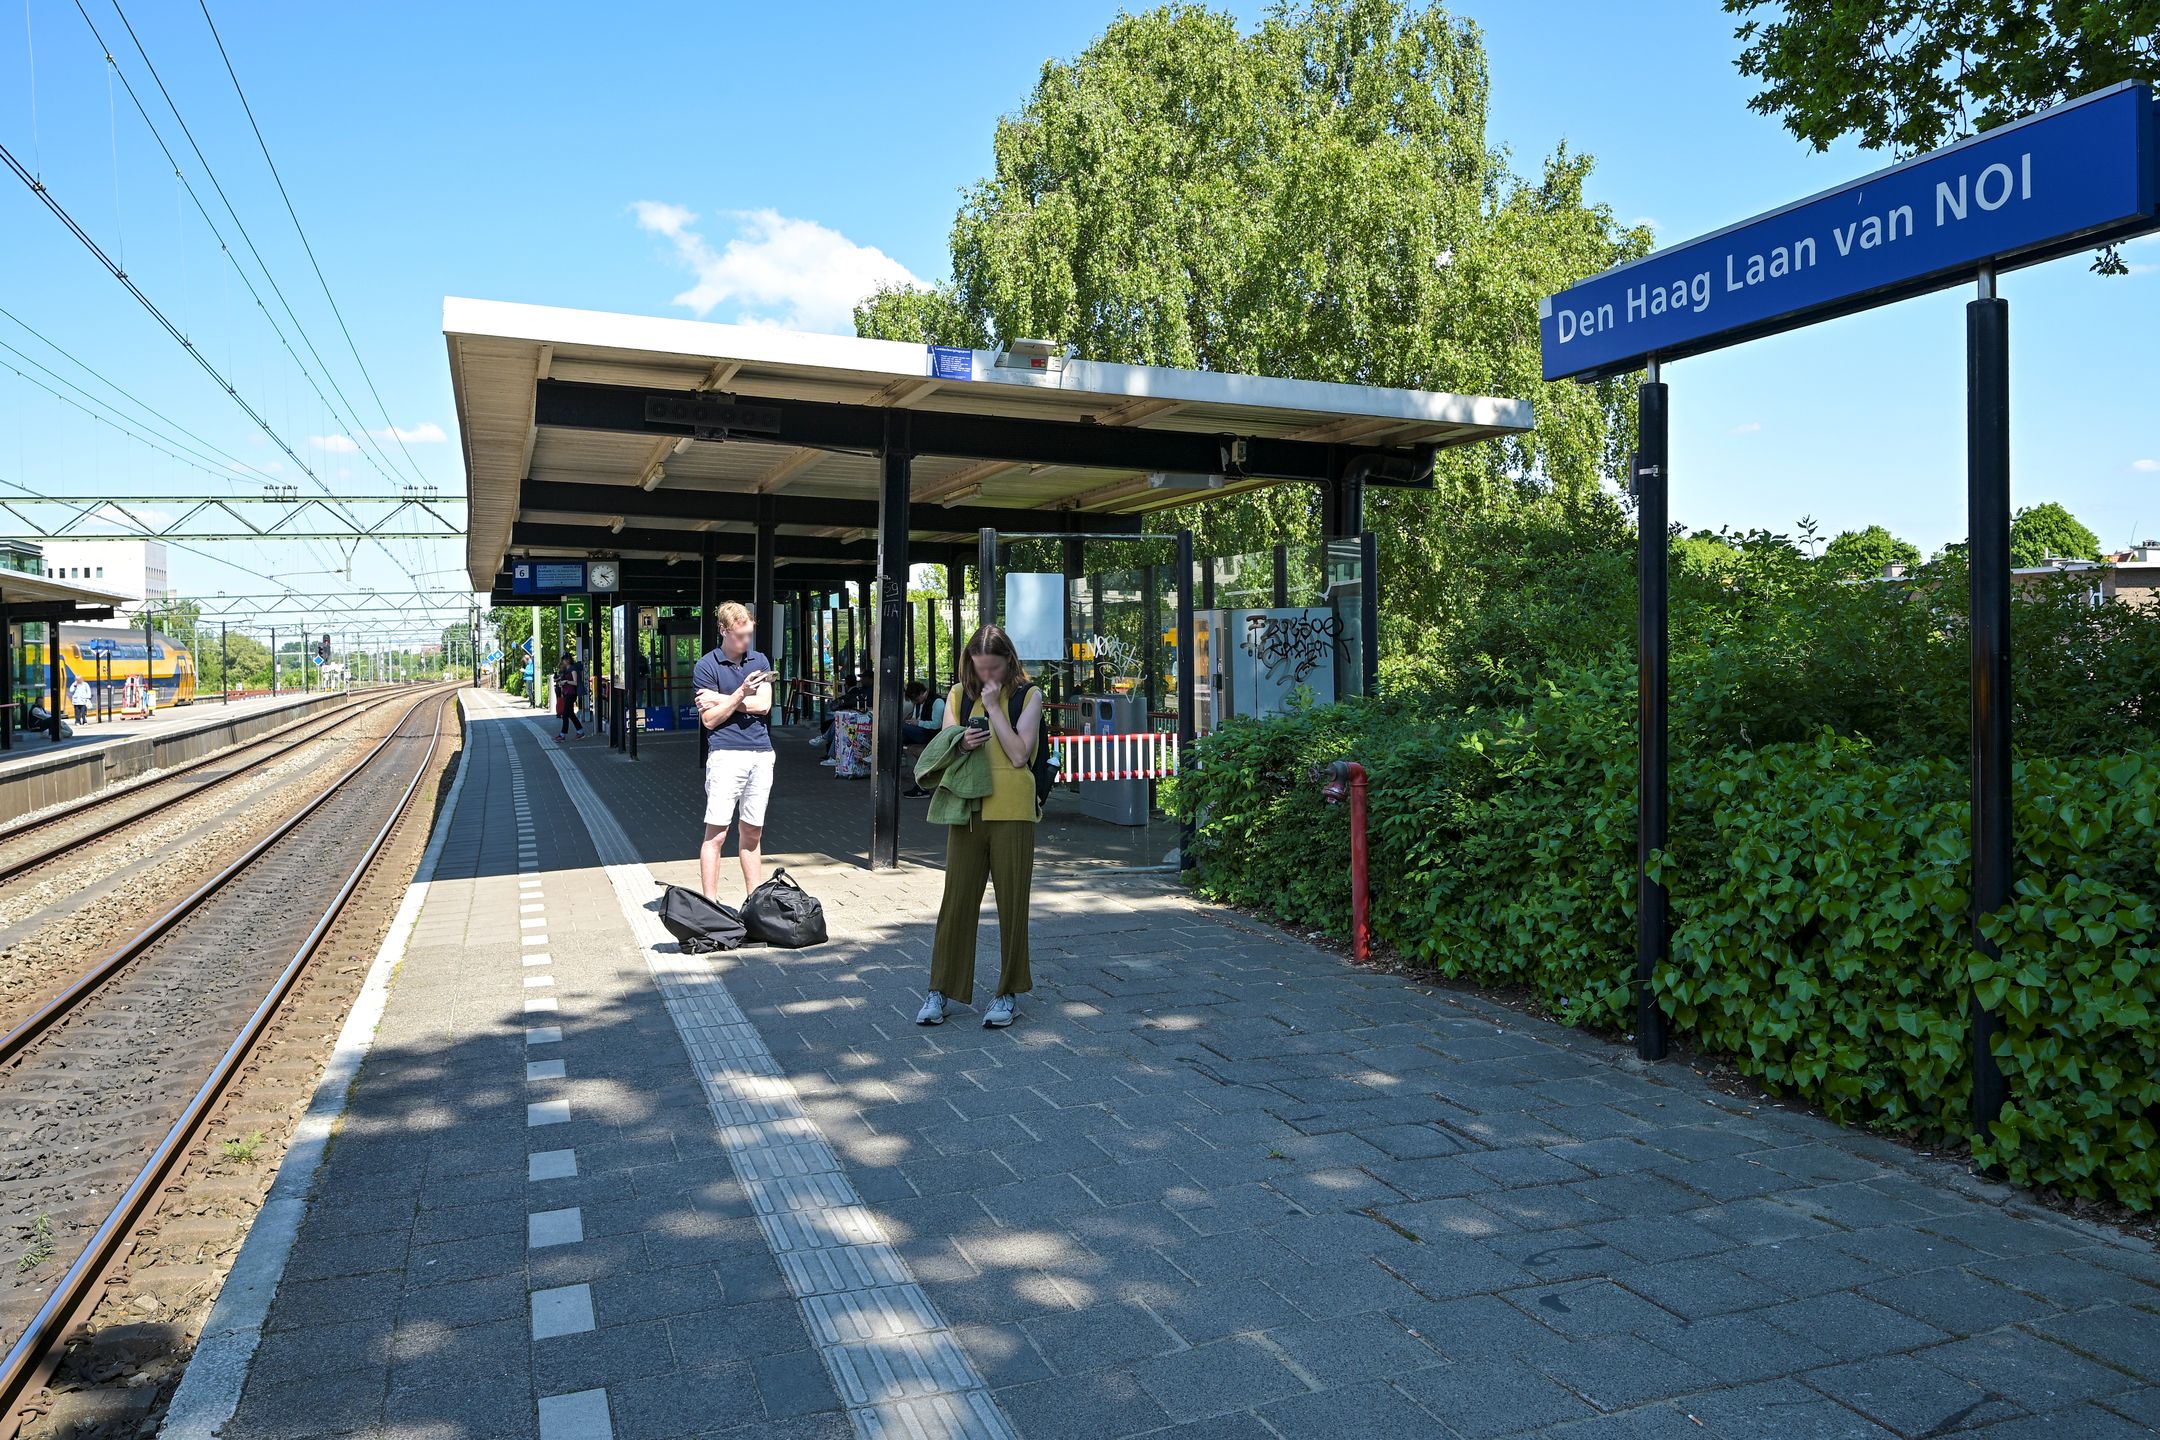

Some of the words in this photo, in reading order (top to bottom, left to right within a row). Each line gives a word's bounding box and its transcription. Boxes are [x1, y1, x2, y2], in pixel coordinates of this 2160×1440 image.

[1557, 302, 1615, 345] Den
[1626, 270, 1712, 324] Haag
[1726, 236, 1817, 293] Laan
[1832, 204, 1914, 257] van
[1936, 152, 2032, 227] NOI
[519, 569, 525, 578] 6
